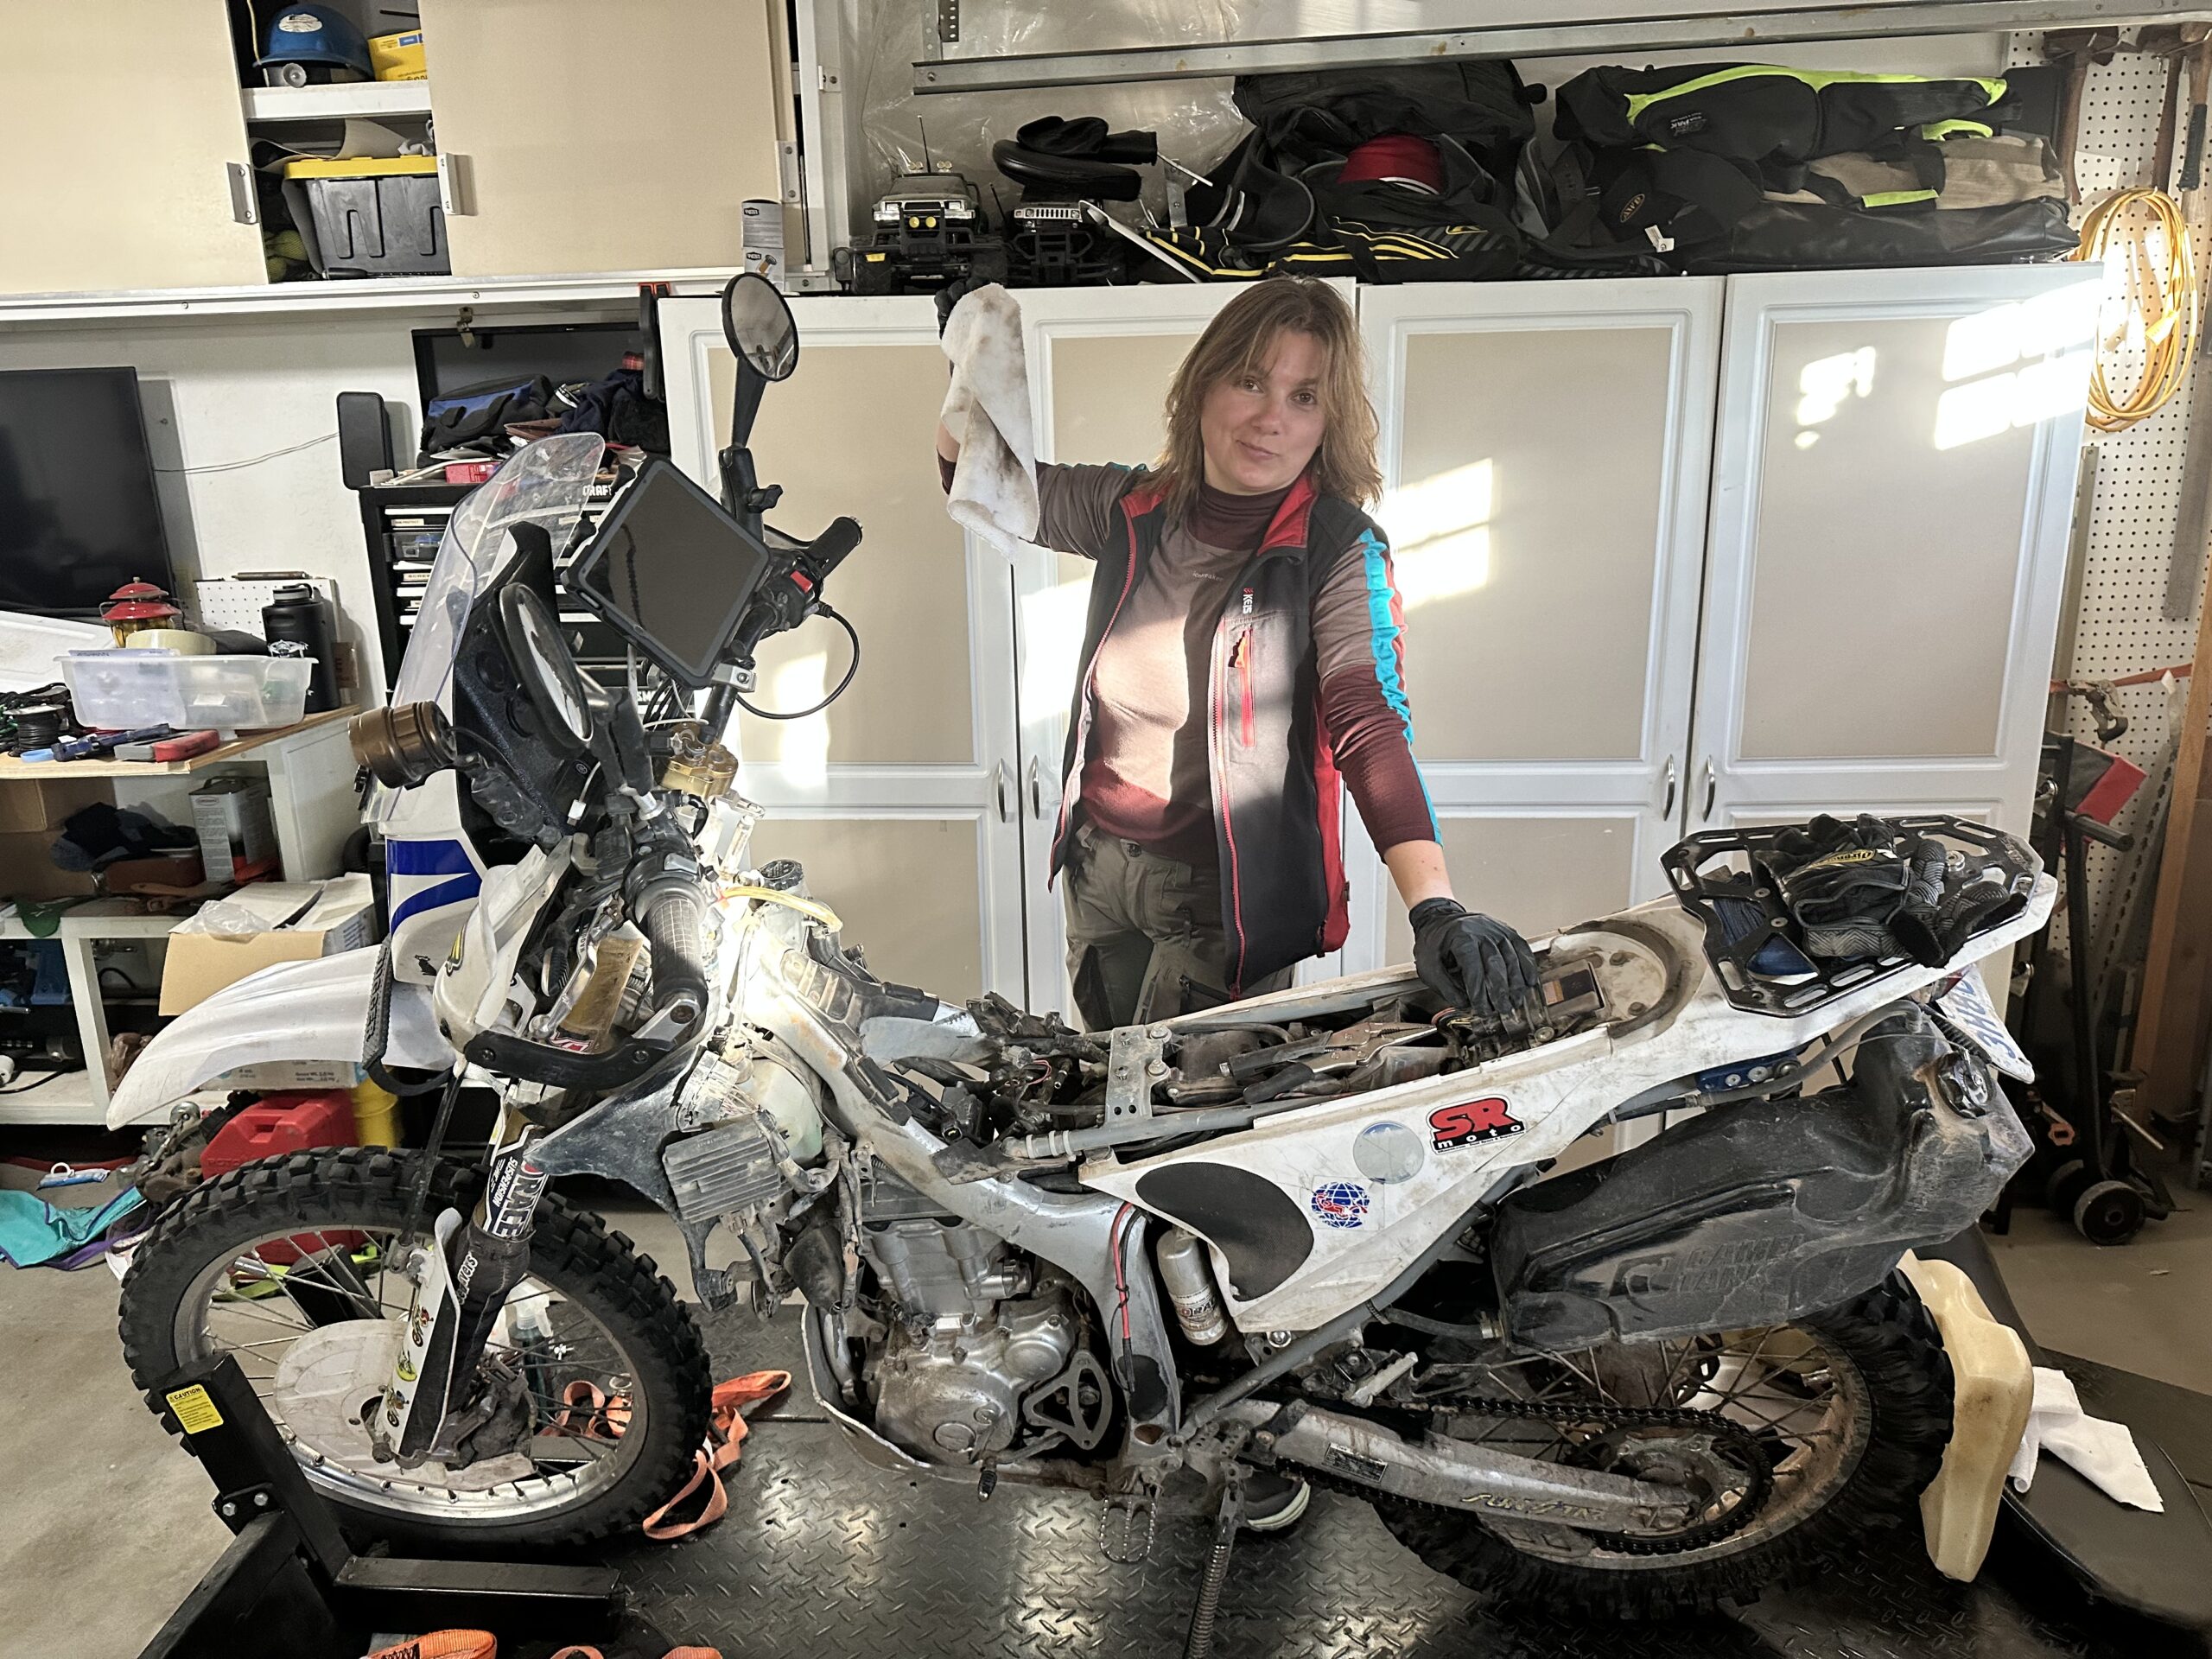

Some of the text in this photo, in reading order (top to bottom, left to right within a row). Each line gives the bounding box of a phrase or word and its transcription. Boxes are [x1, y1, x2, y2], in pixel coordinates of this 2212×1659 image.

[582, 485, 613, 496] CRAF
[1429, 1097, 1516, 1141] SR
[1437, 1124, 1522, 1149] moto
[492, 1156, 518, 1208] SUSPENSION
[174, 1387, 201, 1400] CAUTION
